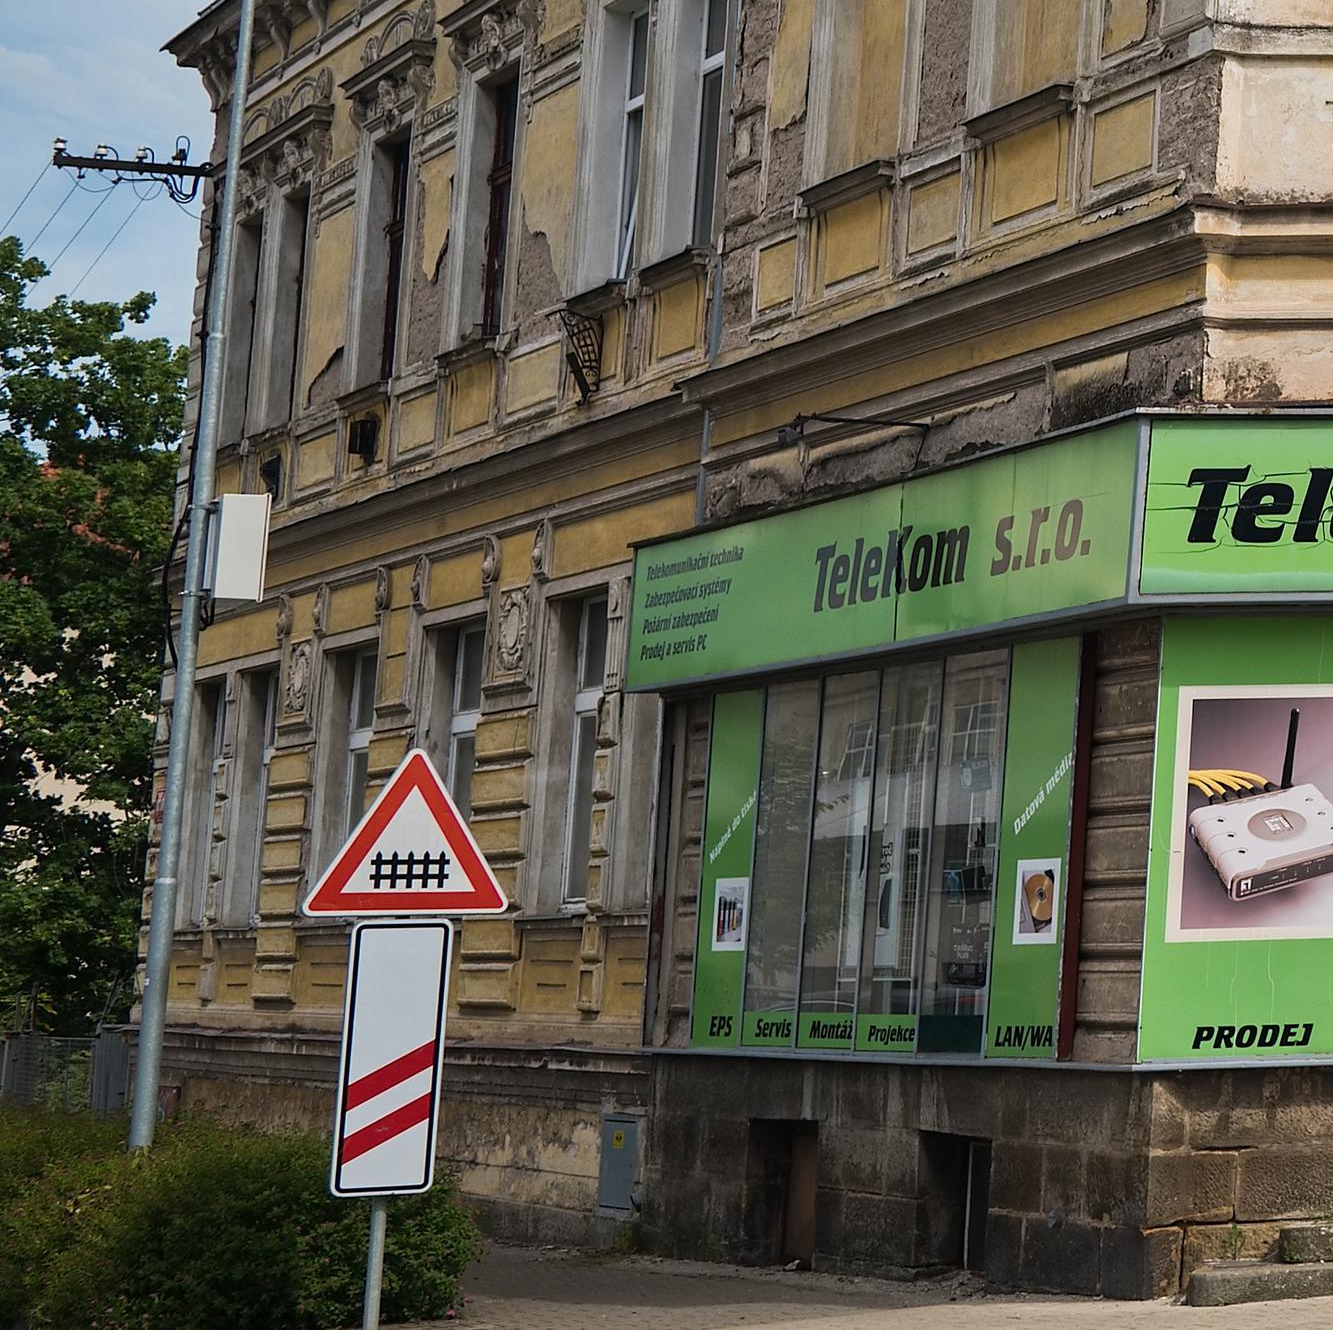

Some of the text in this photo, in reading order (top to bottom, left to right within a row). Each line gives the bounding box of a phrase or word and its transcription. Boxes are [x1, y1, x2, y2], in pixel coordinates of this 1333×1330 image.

[710, 546, 744, 568] technika
[813, 499, 1091, 613] TeleKom s.r.o.
[699, 576, 732, 600] systémy
[672, 604, 720, 629] zabezpečení
[640, 633, 708, 661] Prodej a servis PC
[1013, 786, 1045, 835] Datová
[709, 1015, 733, 1038] EPS
[755, 1018, 792, 1039] Servis
[867, 1025, 916, 1045] Projekce
[1191, 1023, 1314, 1049] PRODEJ
